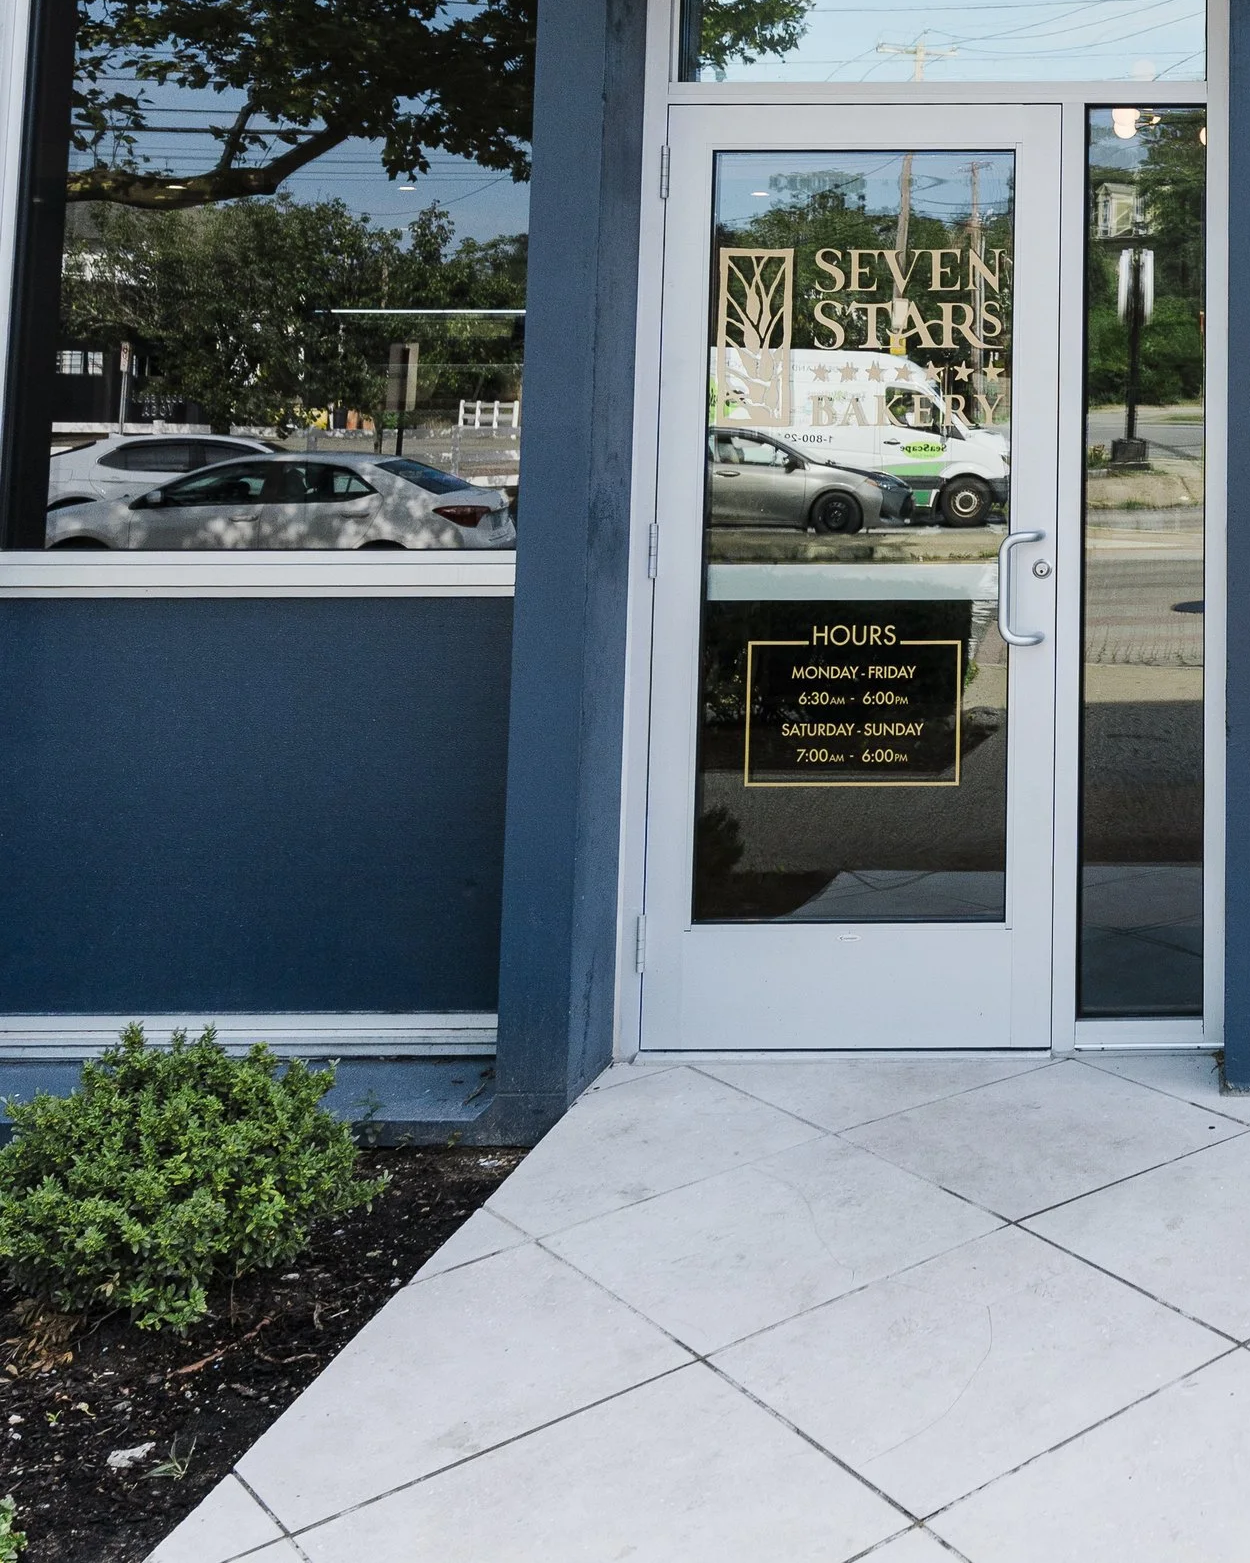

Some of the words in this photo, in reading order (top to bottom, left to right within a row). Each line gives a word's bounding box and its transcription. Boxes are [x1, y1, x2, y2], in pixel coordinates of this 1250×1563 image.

[813, 248, 1007, 293] SEVEN
[813, 300, 1005, 350] STARS
[809, 394, 1005, 428] BAKERY
[813, 625, 896, 646] HOURS
[792, 666, 859, 679] MONDAY
[868, 666, 917, 679] FRIDAY
[781, 723, 855, 736] SATURDAY
[864, 723, 924, 736] SUNDAY
